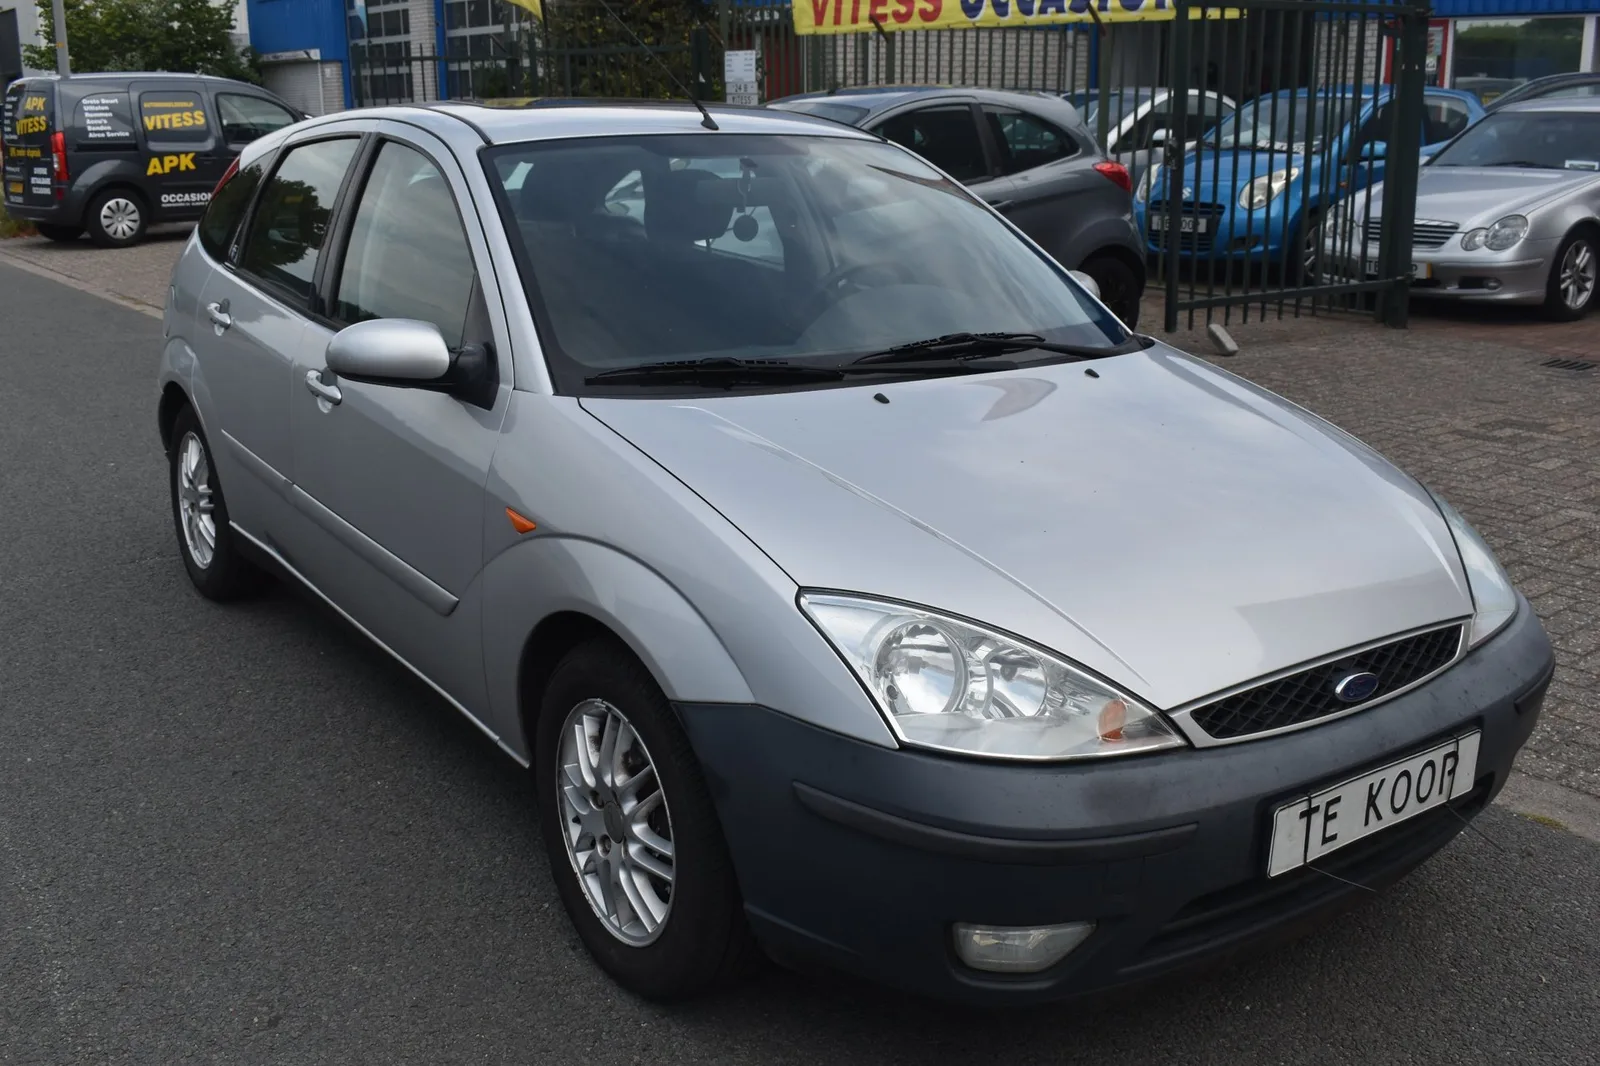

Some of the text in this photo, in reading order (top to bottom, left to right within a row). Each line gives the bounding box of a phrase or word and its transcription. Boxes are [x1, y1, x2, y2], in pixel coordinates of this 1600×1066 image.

[24, 96, 47, 111] APK
[15, 115, 47, 136] VITESS
[143, 110, 206, 131] VITESS
[146, 152, 196, 176] APK
[1299, 750, 1460, 849] TE KOOP
